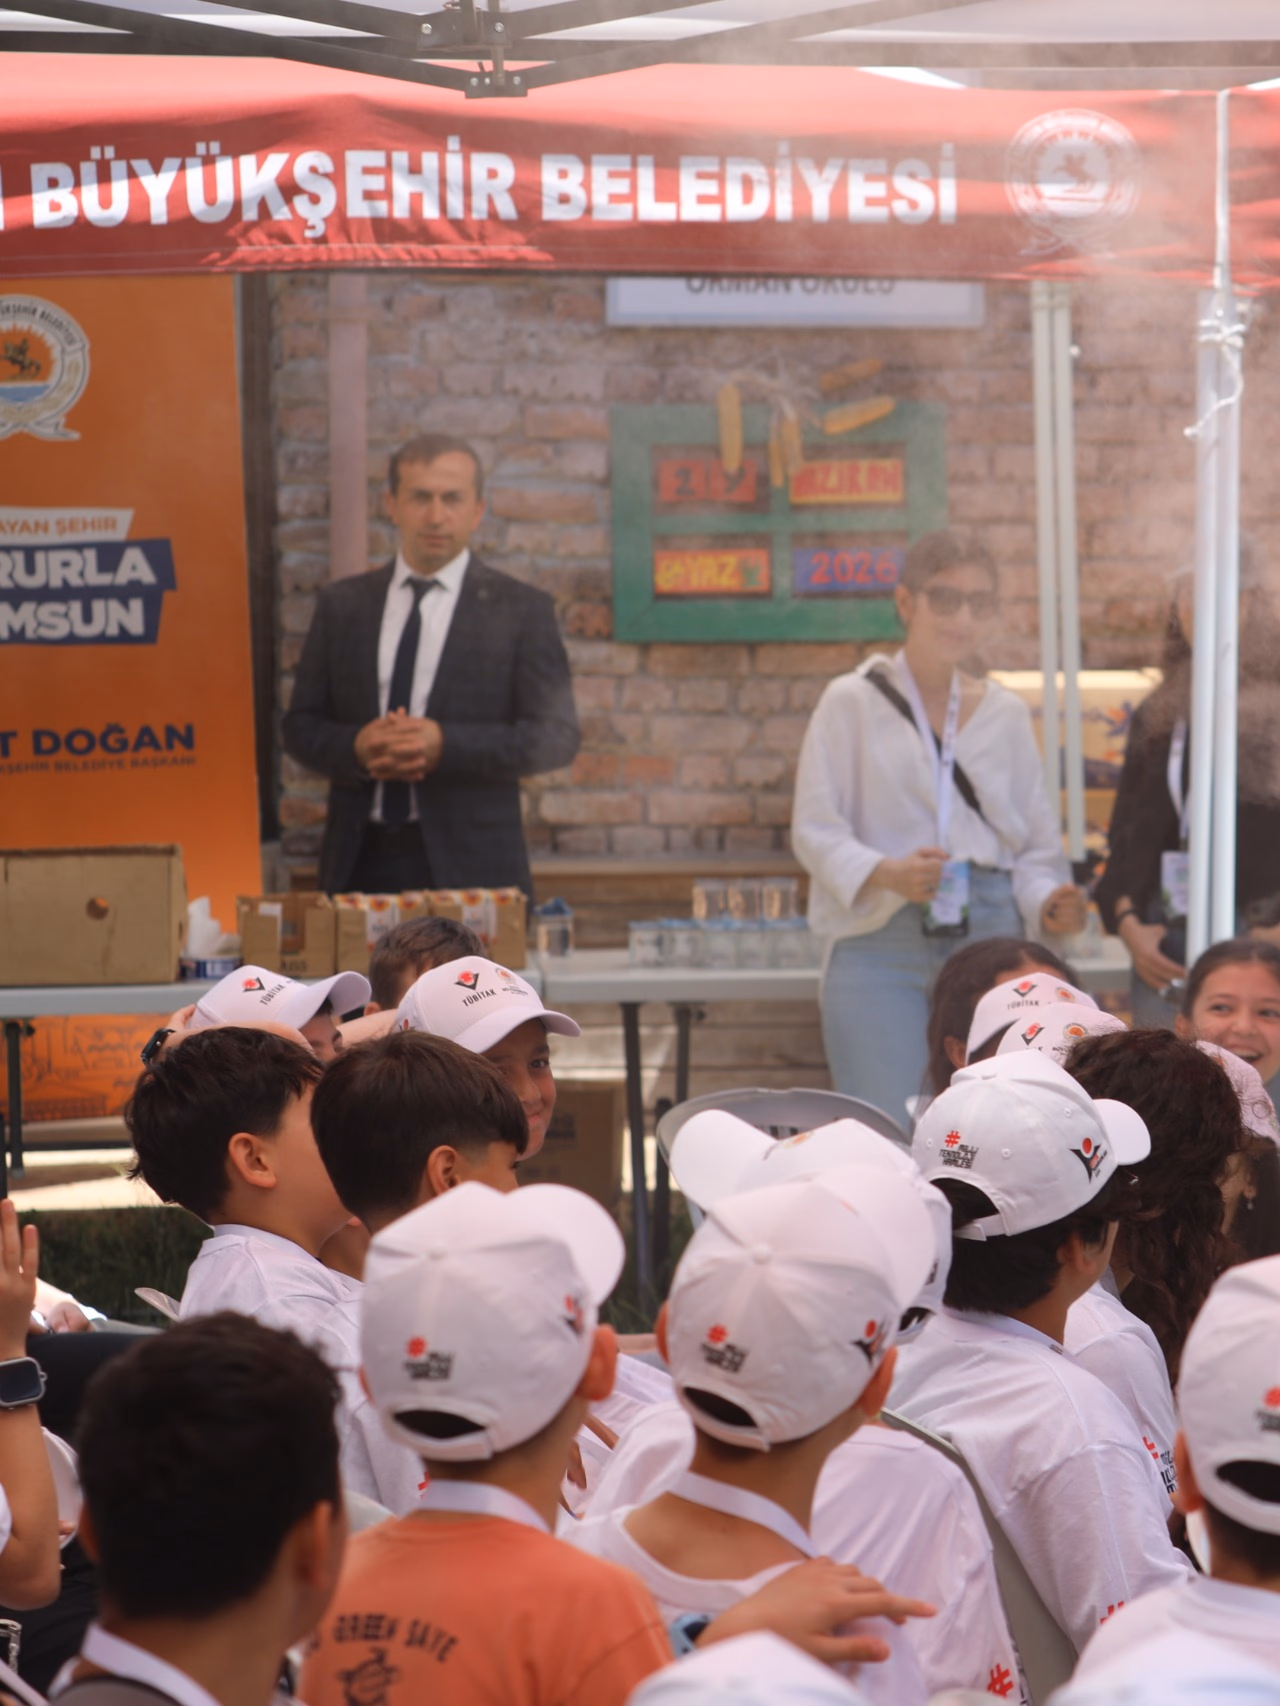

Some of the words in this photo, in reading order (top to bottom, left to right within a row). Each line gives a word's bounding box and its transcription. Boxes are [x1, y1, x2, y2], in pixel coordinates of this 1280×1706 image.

[29, 135, 519, 238] BÜYÜKŞEHİR
[541, 141, 957, 225] BELEDİYESİ
[810, 551, 898, 585] 2026
[32, 722, 195, 756] DOĞAN
[259, 984, 286, 1006] TÜBİTAK
[462, 988, 497, 1008] TÜBİTAK
[333, 1611, 400, 1644] GREEN
